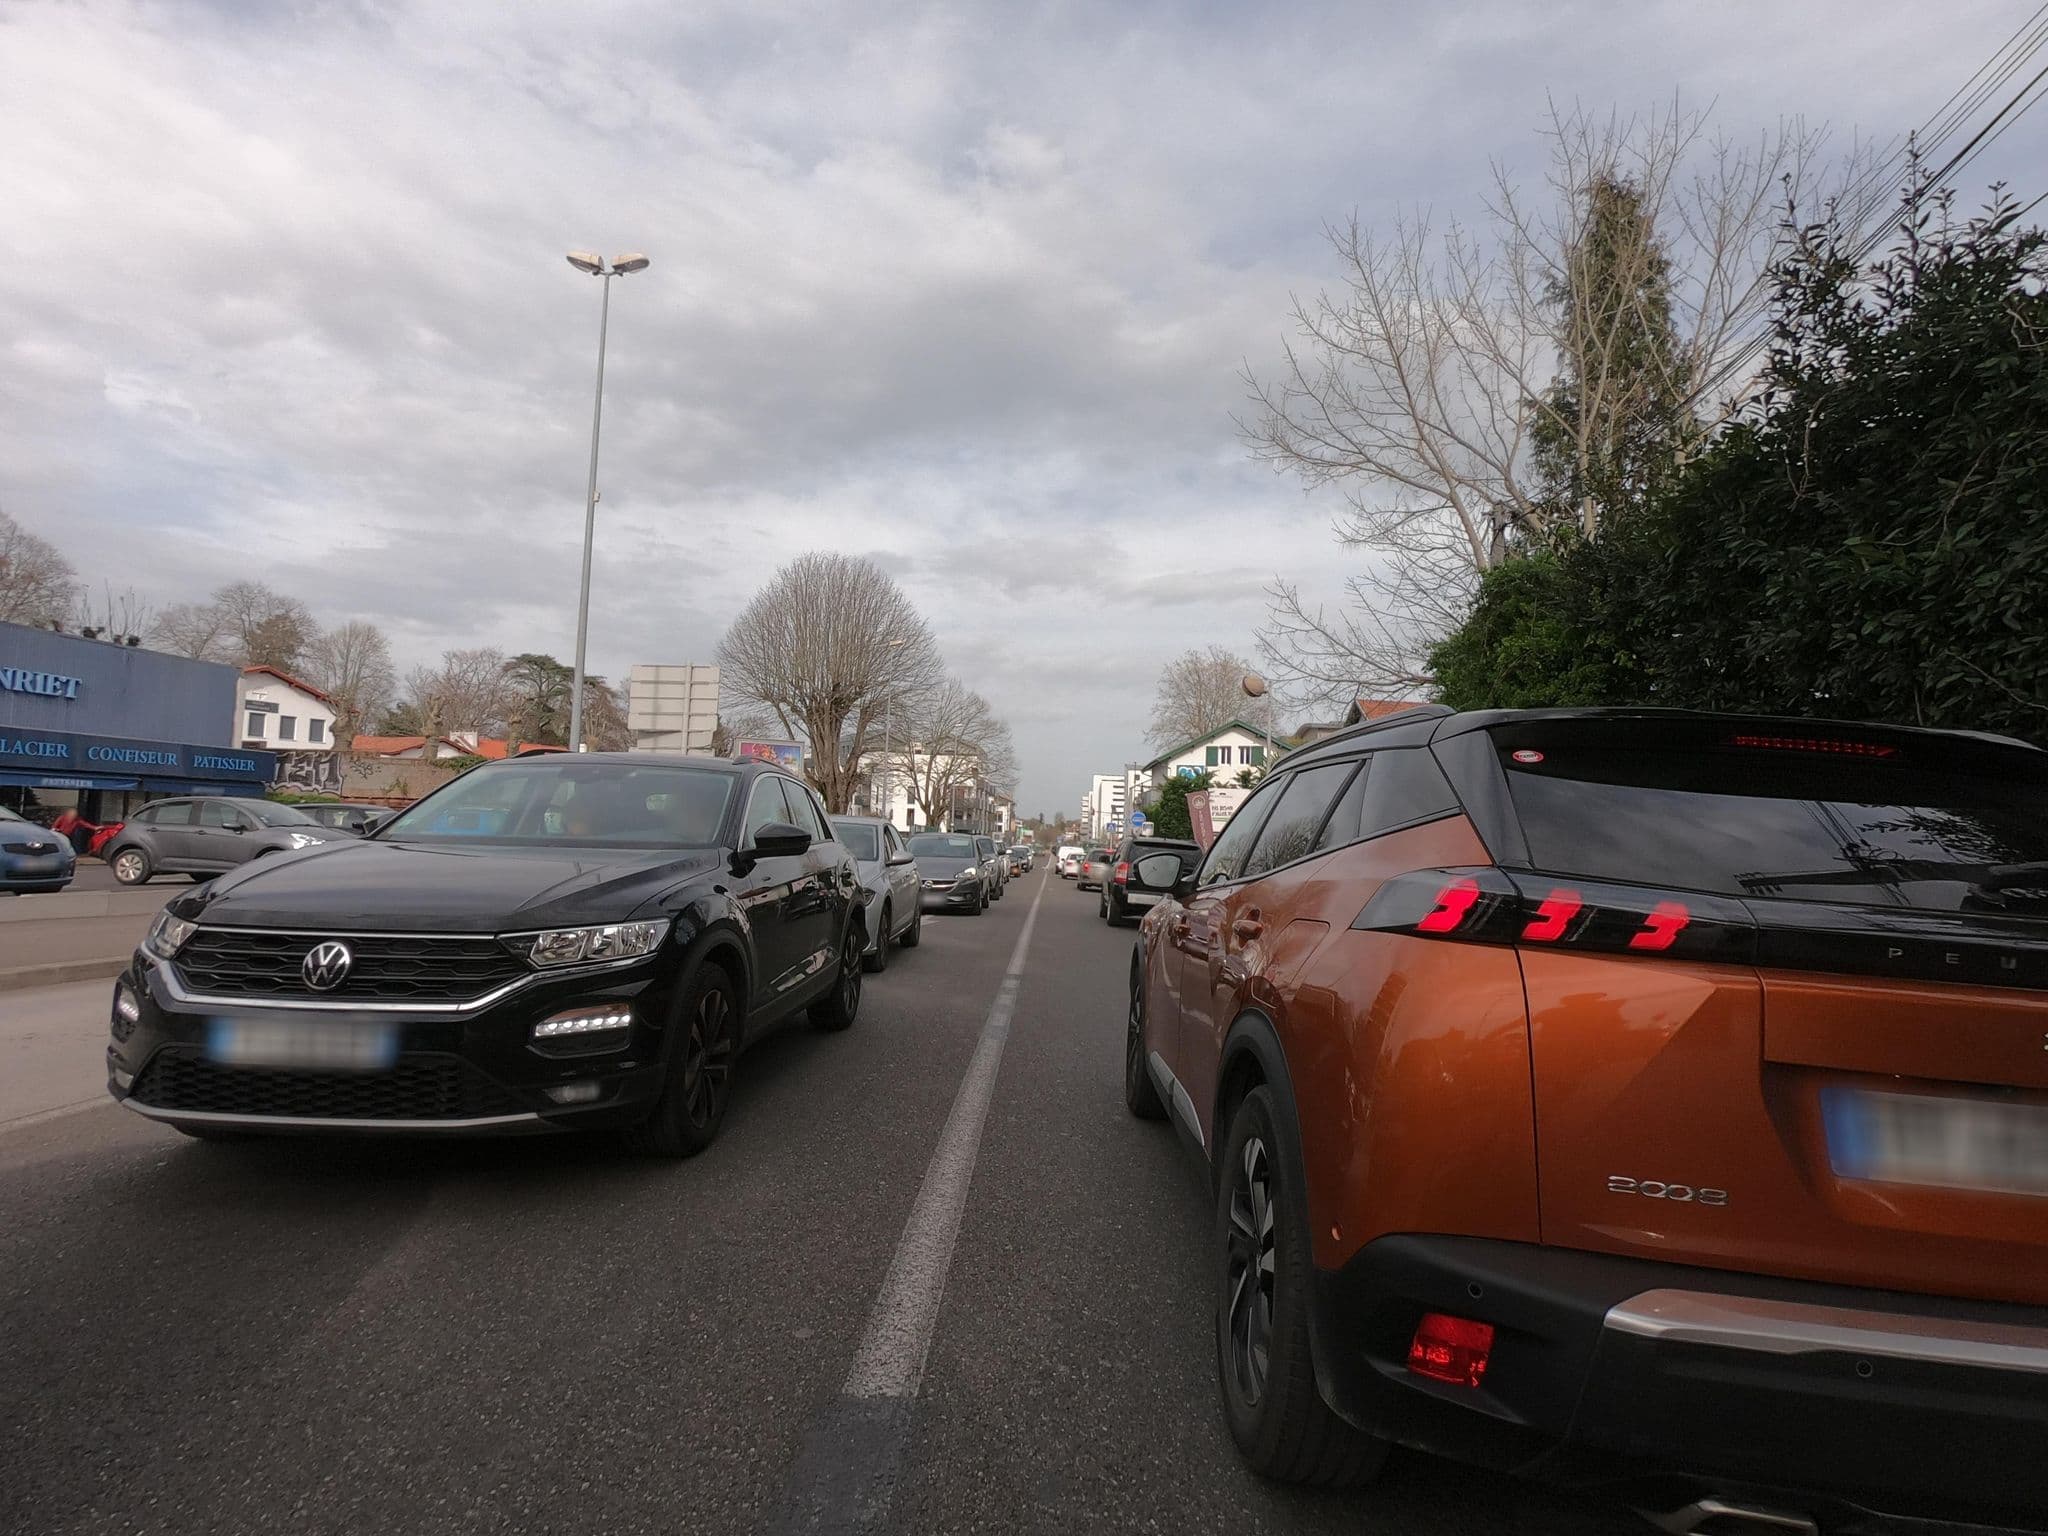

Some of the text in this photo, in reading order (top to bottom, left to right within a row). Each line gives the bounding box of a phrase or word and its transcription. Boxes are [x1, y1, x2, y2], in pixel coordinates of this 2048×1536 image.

[88, 746, 177, 766] CONFISEUR
[194, 755, 255, 771] PATISSIER
[1607, 1175, 1728, 1205] 2008
